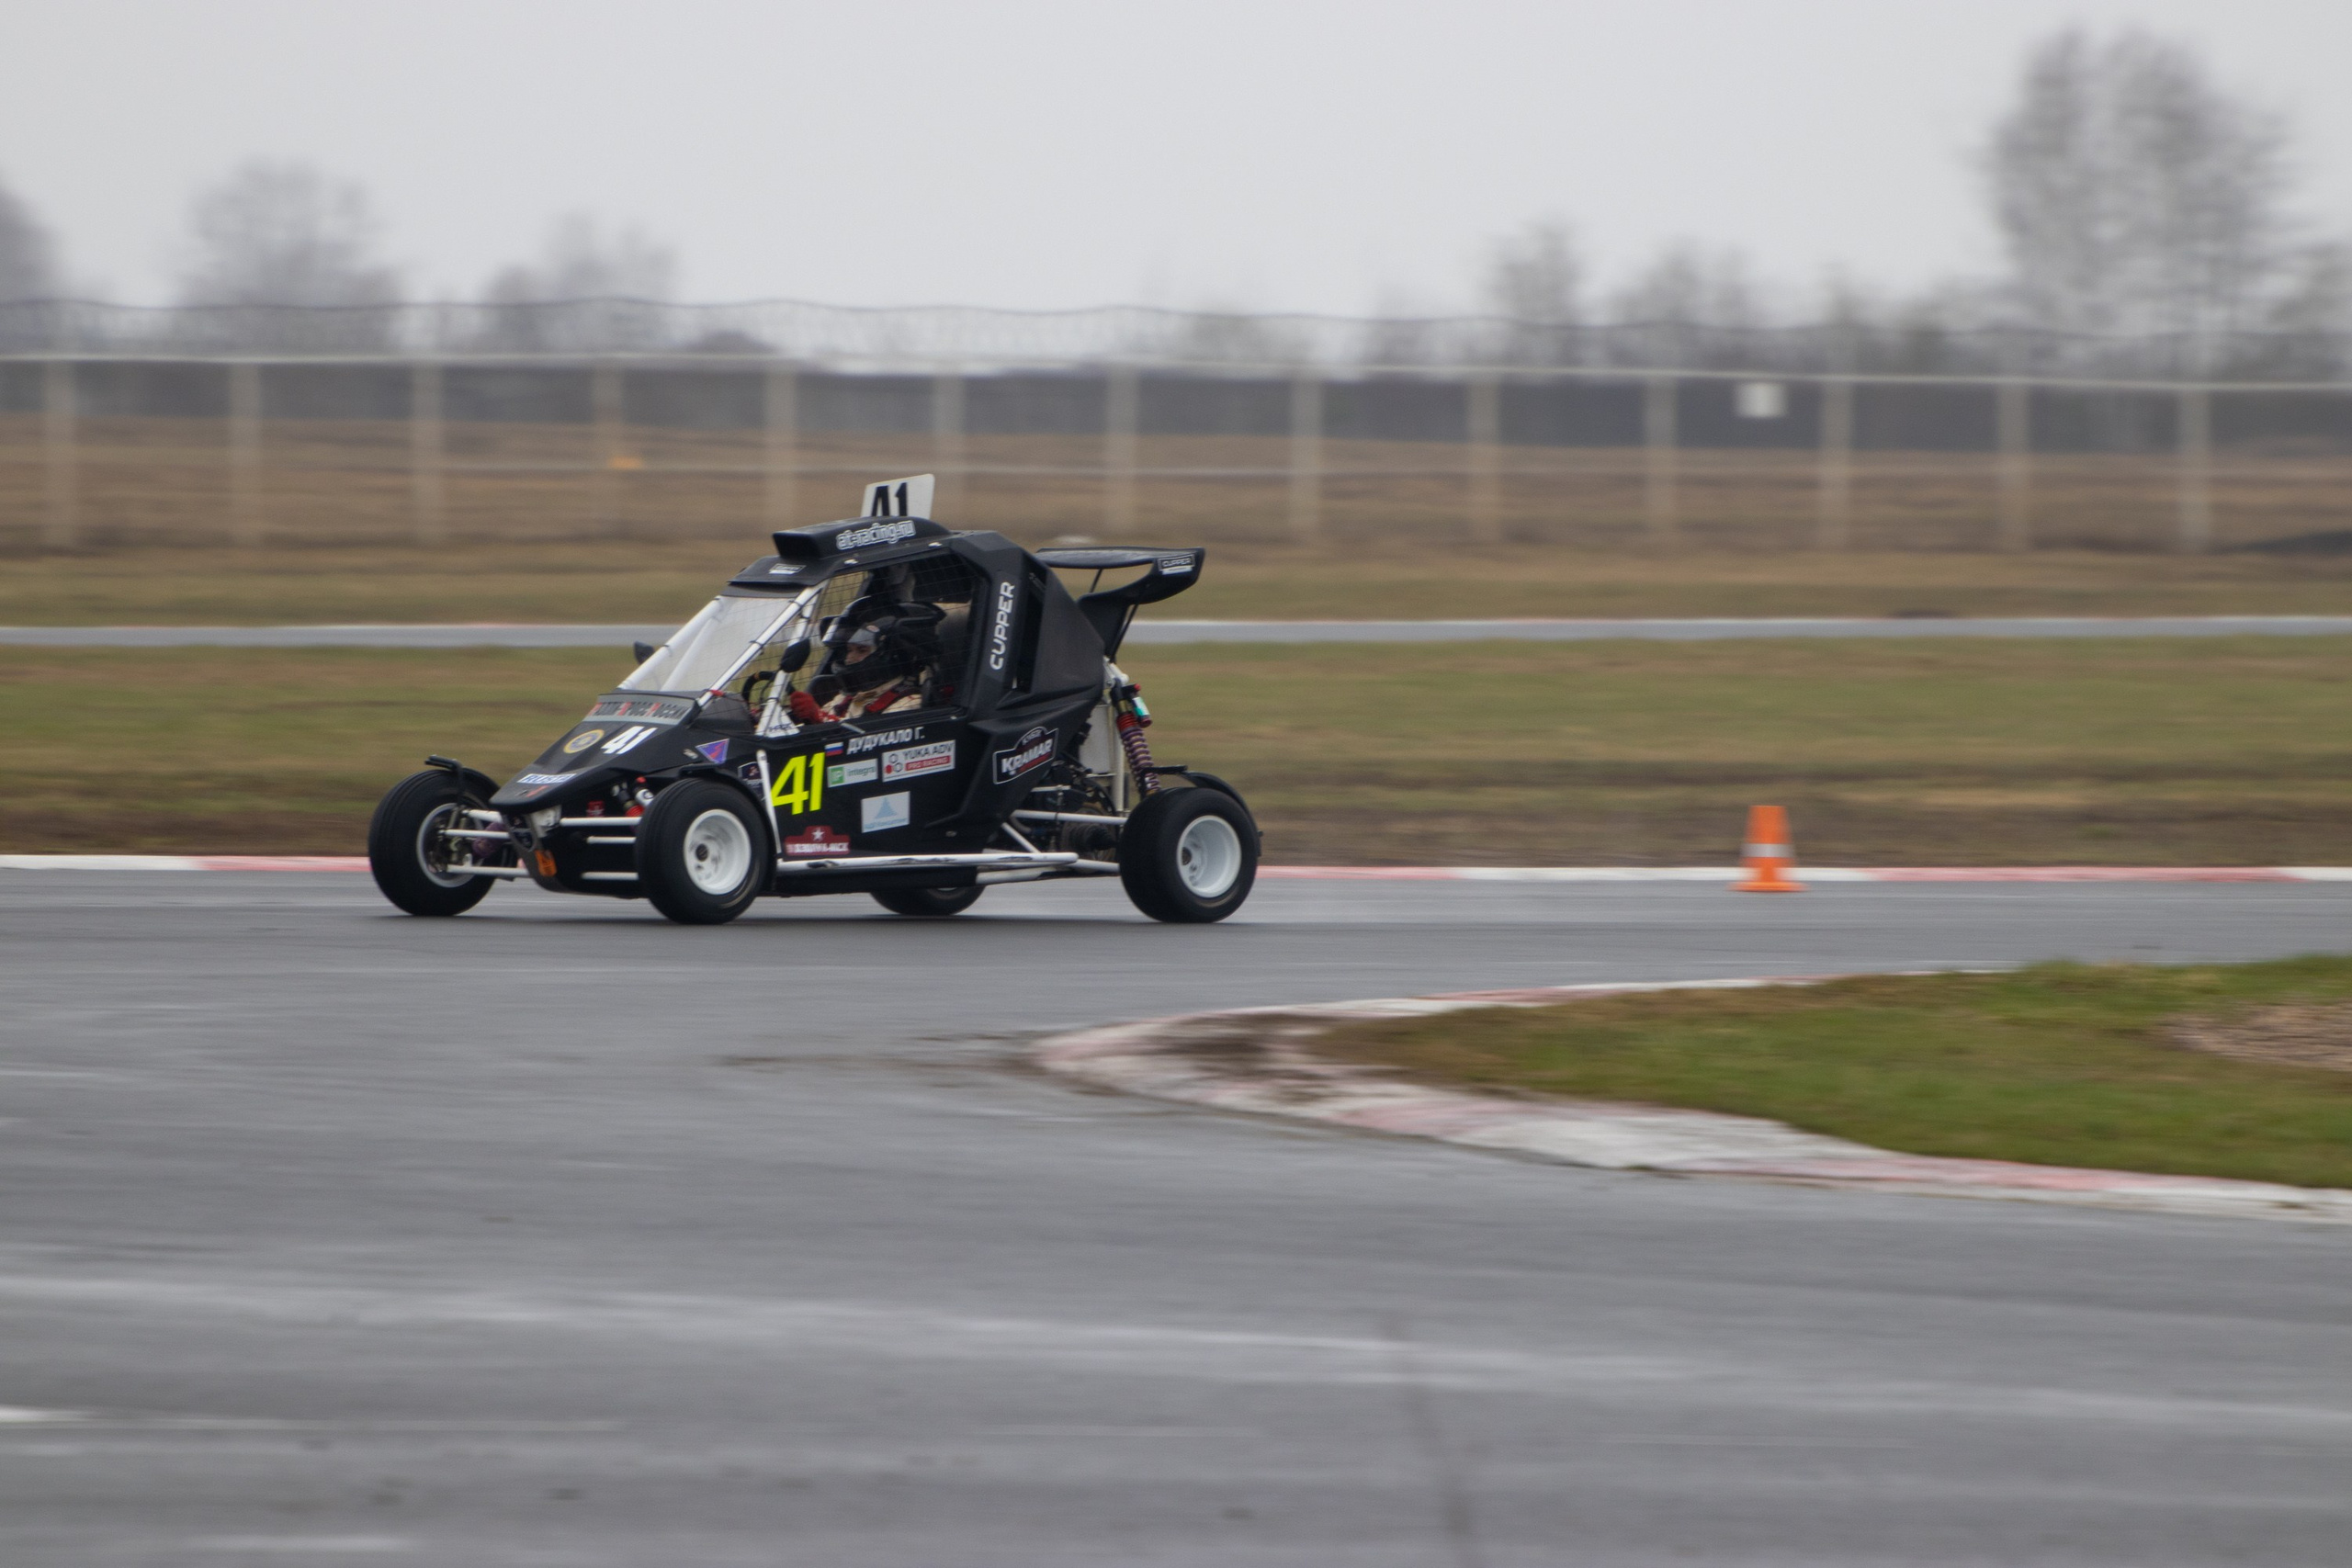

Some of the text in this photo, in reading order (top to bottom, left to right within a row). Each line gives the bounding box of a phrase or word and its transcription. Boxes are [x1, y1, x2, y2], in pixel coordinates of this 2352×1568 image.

[870, 482, 908, 516] 41
[836, 520, 916, 550] at-racing.ru
[989, 581, 1015, 671] CUPPER
[601, 726, 658, 754] 41
[846, 728, 912, 754] ДУДУКАЛО
[902, 743, 956, 761] YUKA ADV
[922, 756, 948, 767] RACING
[771, 752, 825, 815] 41
